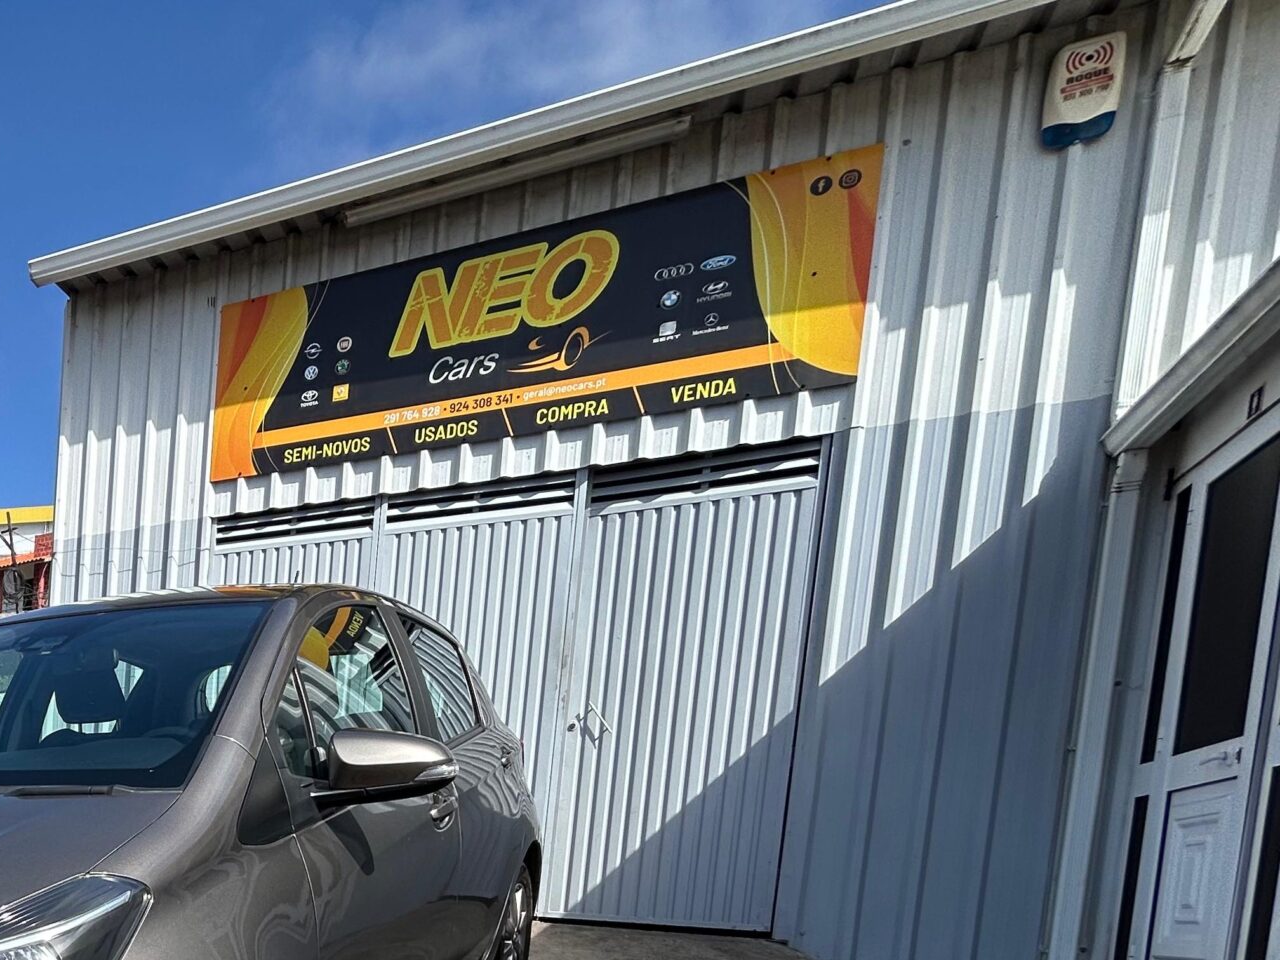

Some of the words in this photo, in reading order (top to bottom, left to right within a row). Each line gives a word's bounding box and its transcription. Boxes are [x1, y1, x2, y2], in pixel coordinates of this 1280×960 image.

[389, 230, 620, 358] NEO
[652, 333, 681, 343] SEAT
[428, 353, 499, 384] Cars
[300, 400, 319, 408] TOYOTA
[383, 412, 400, 424] 291
[402, 409, 420, 421] 764
[449, 400, 469, 413] 924
[472, 397, 492, 409] 308
[495, 393, 513, 405] 341
[522, 378, 606, 401] geral@neocars.pt
[670, 378, 737, 403] VENDA
[535, 398, 609, 425] COMPRA
[414, 420, 478, 444] USADOS
[284, 437, 371, 464] SEMI-NOVOS
